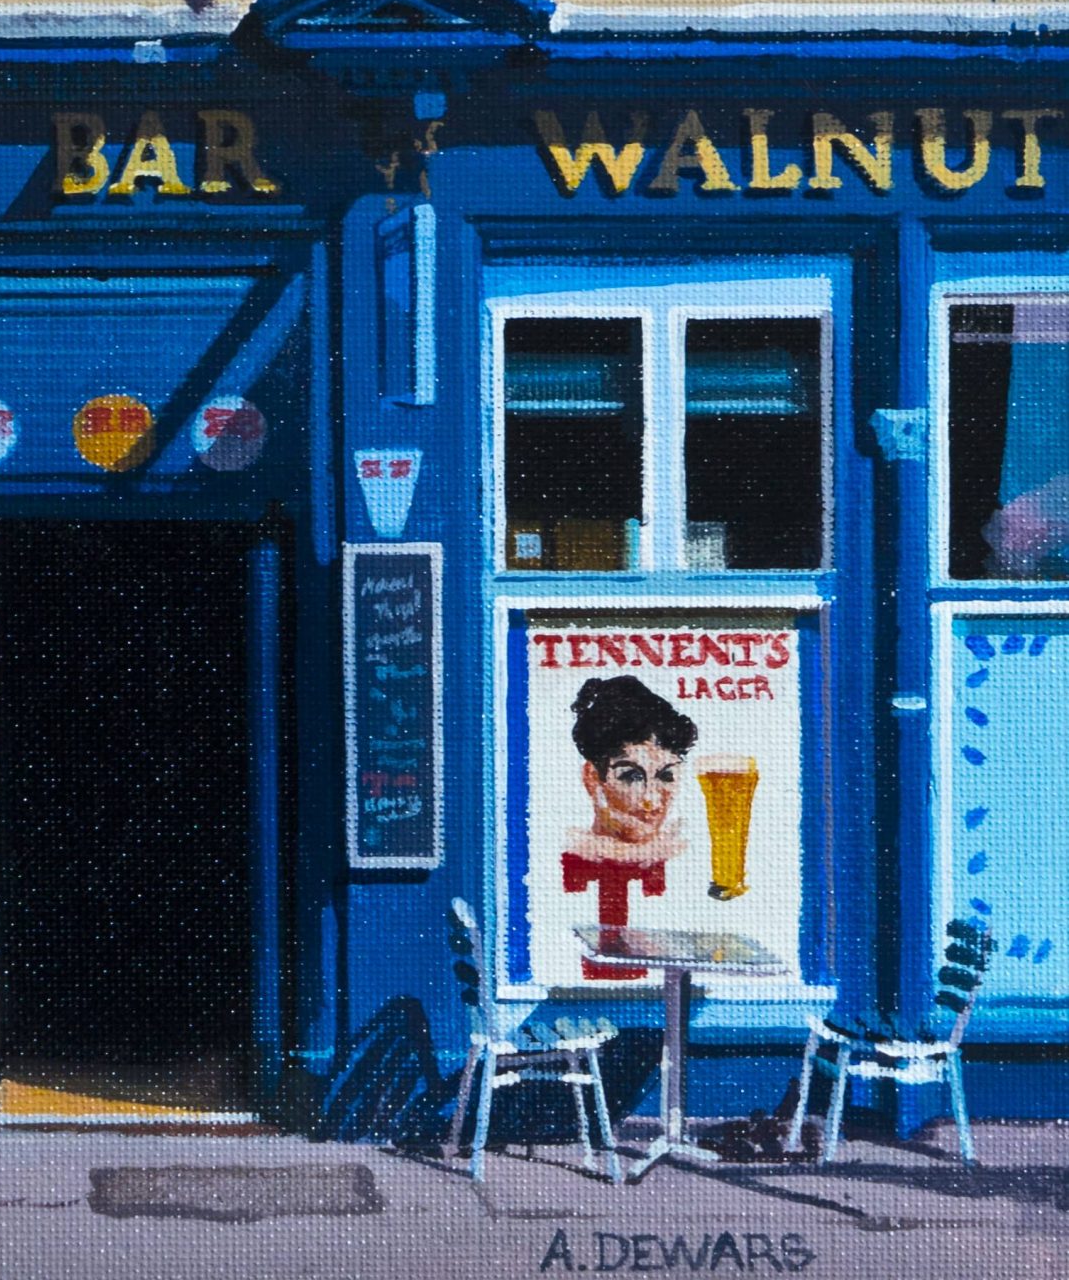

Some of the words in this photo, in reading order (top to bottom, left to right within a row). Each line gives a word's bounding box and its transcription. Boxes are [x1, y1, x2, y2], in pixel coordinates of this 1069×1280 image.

[48, 109, 281, 195] BAR
[534, 107, 1066, 193] WALNUT
[533, 632, 791, 669] TENNENT'S
